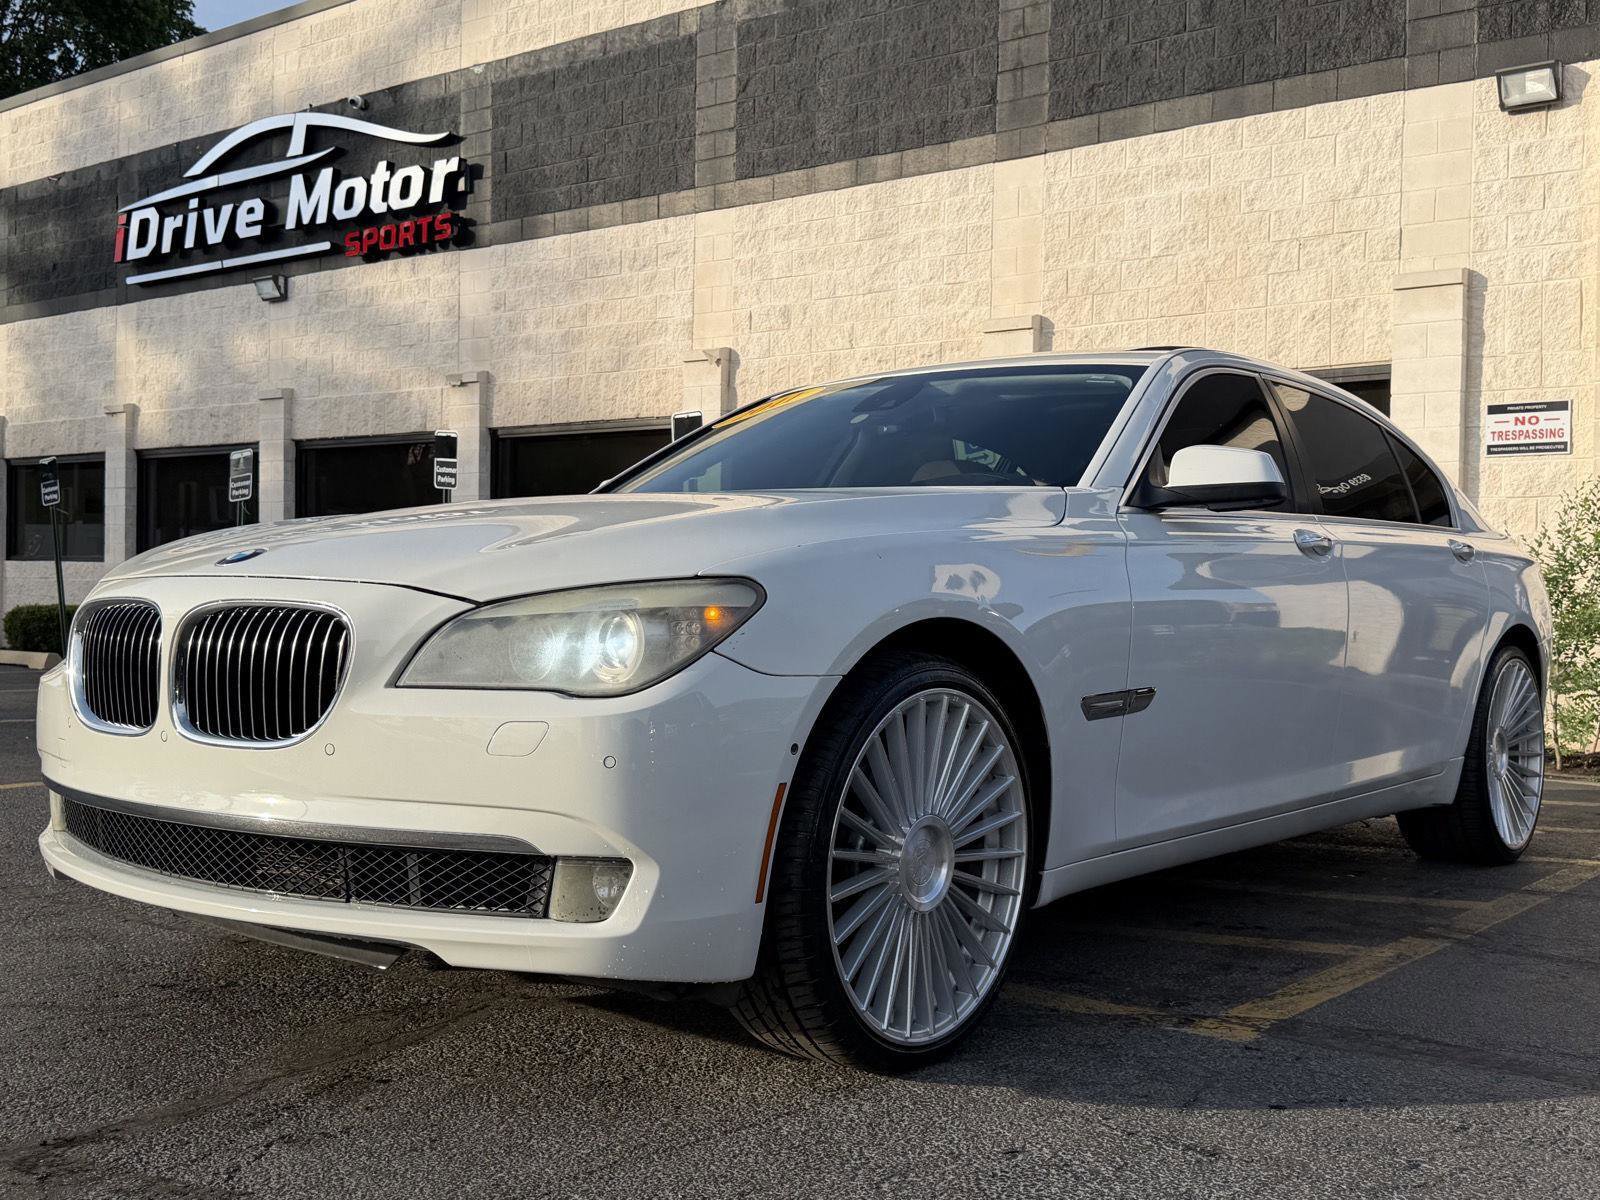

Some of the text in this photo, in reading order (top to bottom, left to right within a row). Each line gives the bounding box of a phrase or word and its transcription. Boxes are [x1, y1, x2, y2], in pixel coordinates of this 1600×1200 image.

[114, 156, 460, 263] iDrive Motor
[345, 213, 453, 257] SPORTS
[1514, 416, 1540, 426] NO
[1490, 428, 1565, 442] TRESPASSING
[437, 465, 457, 474] Customer
[231, 480, 251, 489] Customer
[438, 475, 455, 485] Parking
[42, 486, 58, 494] Customer
[232, 488, 249, 496] Parking
[44, 493, 58, 502] Parking
